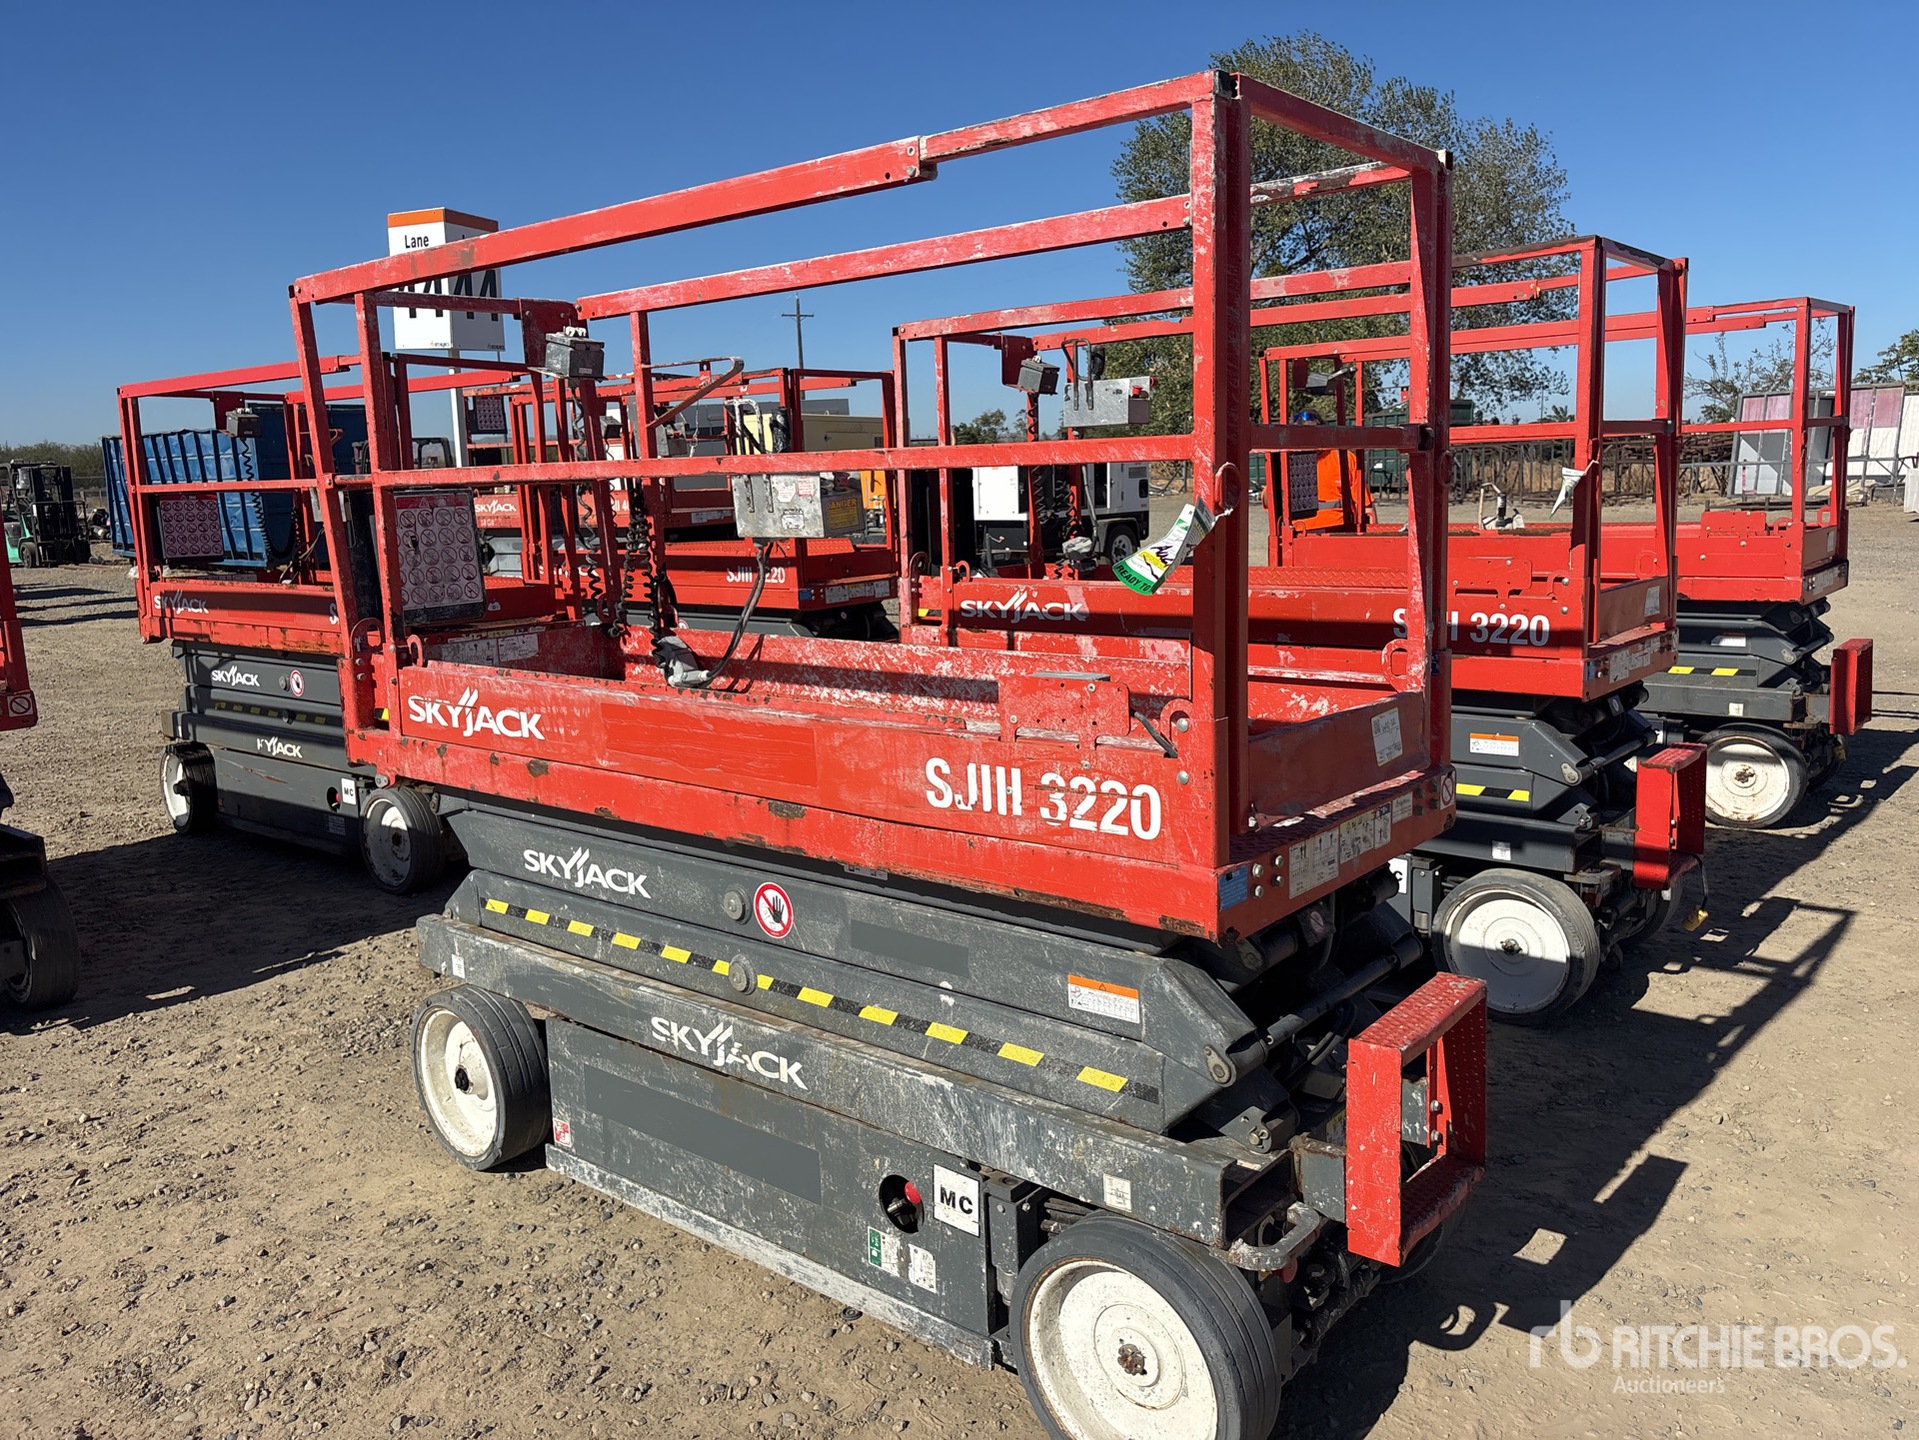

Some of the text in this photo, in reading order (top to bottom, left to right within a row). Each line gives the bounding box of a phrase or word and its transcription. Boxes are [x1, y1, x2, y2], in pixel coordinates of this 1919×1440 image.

[404, 234, 429, 248] Lane
[475, 499, 517, 514] SKYJACK
[1116, 563, 1141, 587] READY
[154, 589, 209, 614] SKYJACK
[960, 587, 1087, 623] SKYJACK
[1469, 611, 1550, 646] 3220
[211, 665, 261, 687] SKYJACK
[408, 686, 545, 740] SKYJACK
[1039, 771, 1162, 840] 3220
[523, 846, 652, 899] SKYJACK
[651, 1016, 809, 1091] SKYJACK
[939, 1184, 974, 1216] MC
